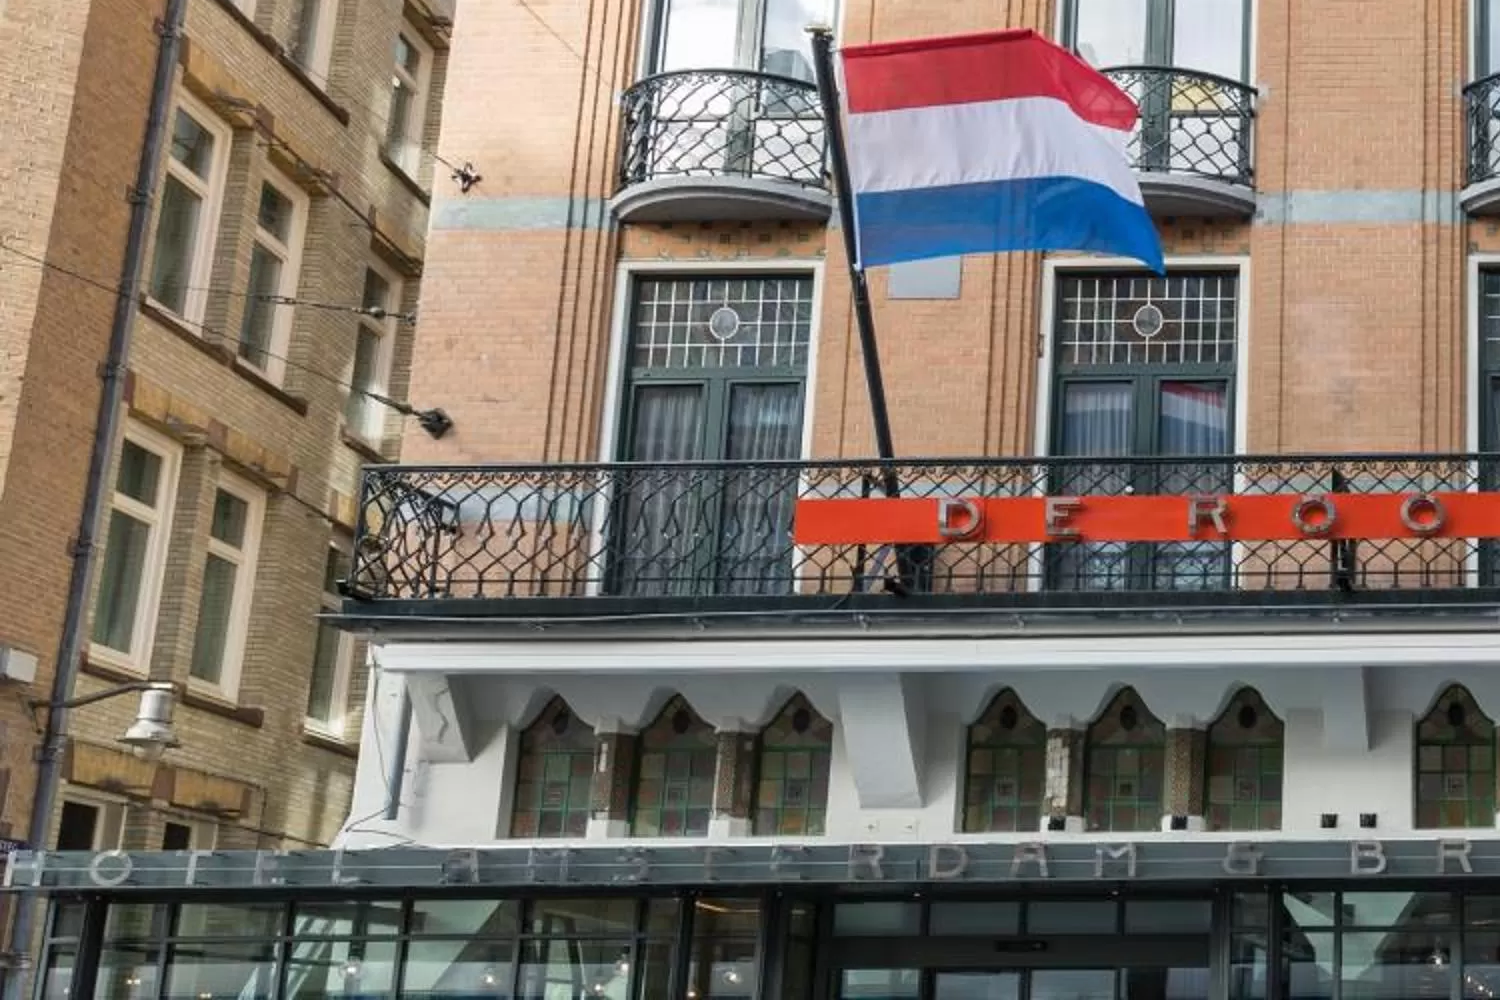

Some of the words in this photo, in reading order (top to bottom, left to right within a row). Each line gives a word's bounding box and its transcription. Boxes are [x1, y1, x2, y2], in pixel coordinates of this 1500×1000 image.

[936, 496, 1083, 541] DE
[3, 849, 361, 887] HOTEL
[1223, 843, 1266, 875] &
